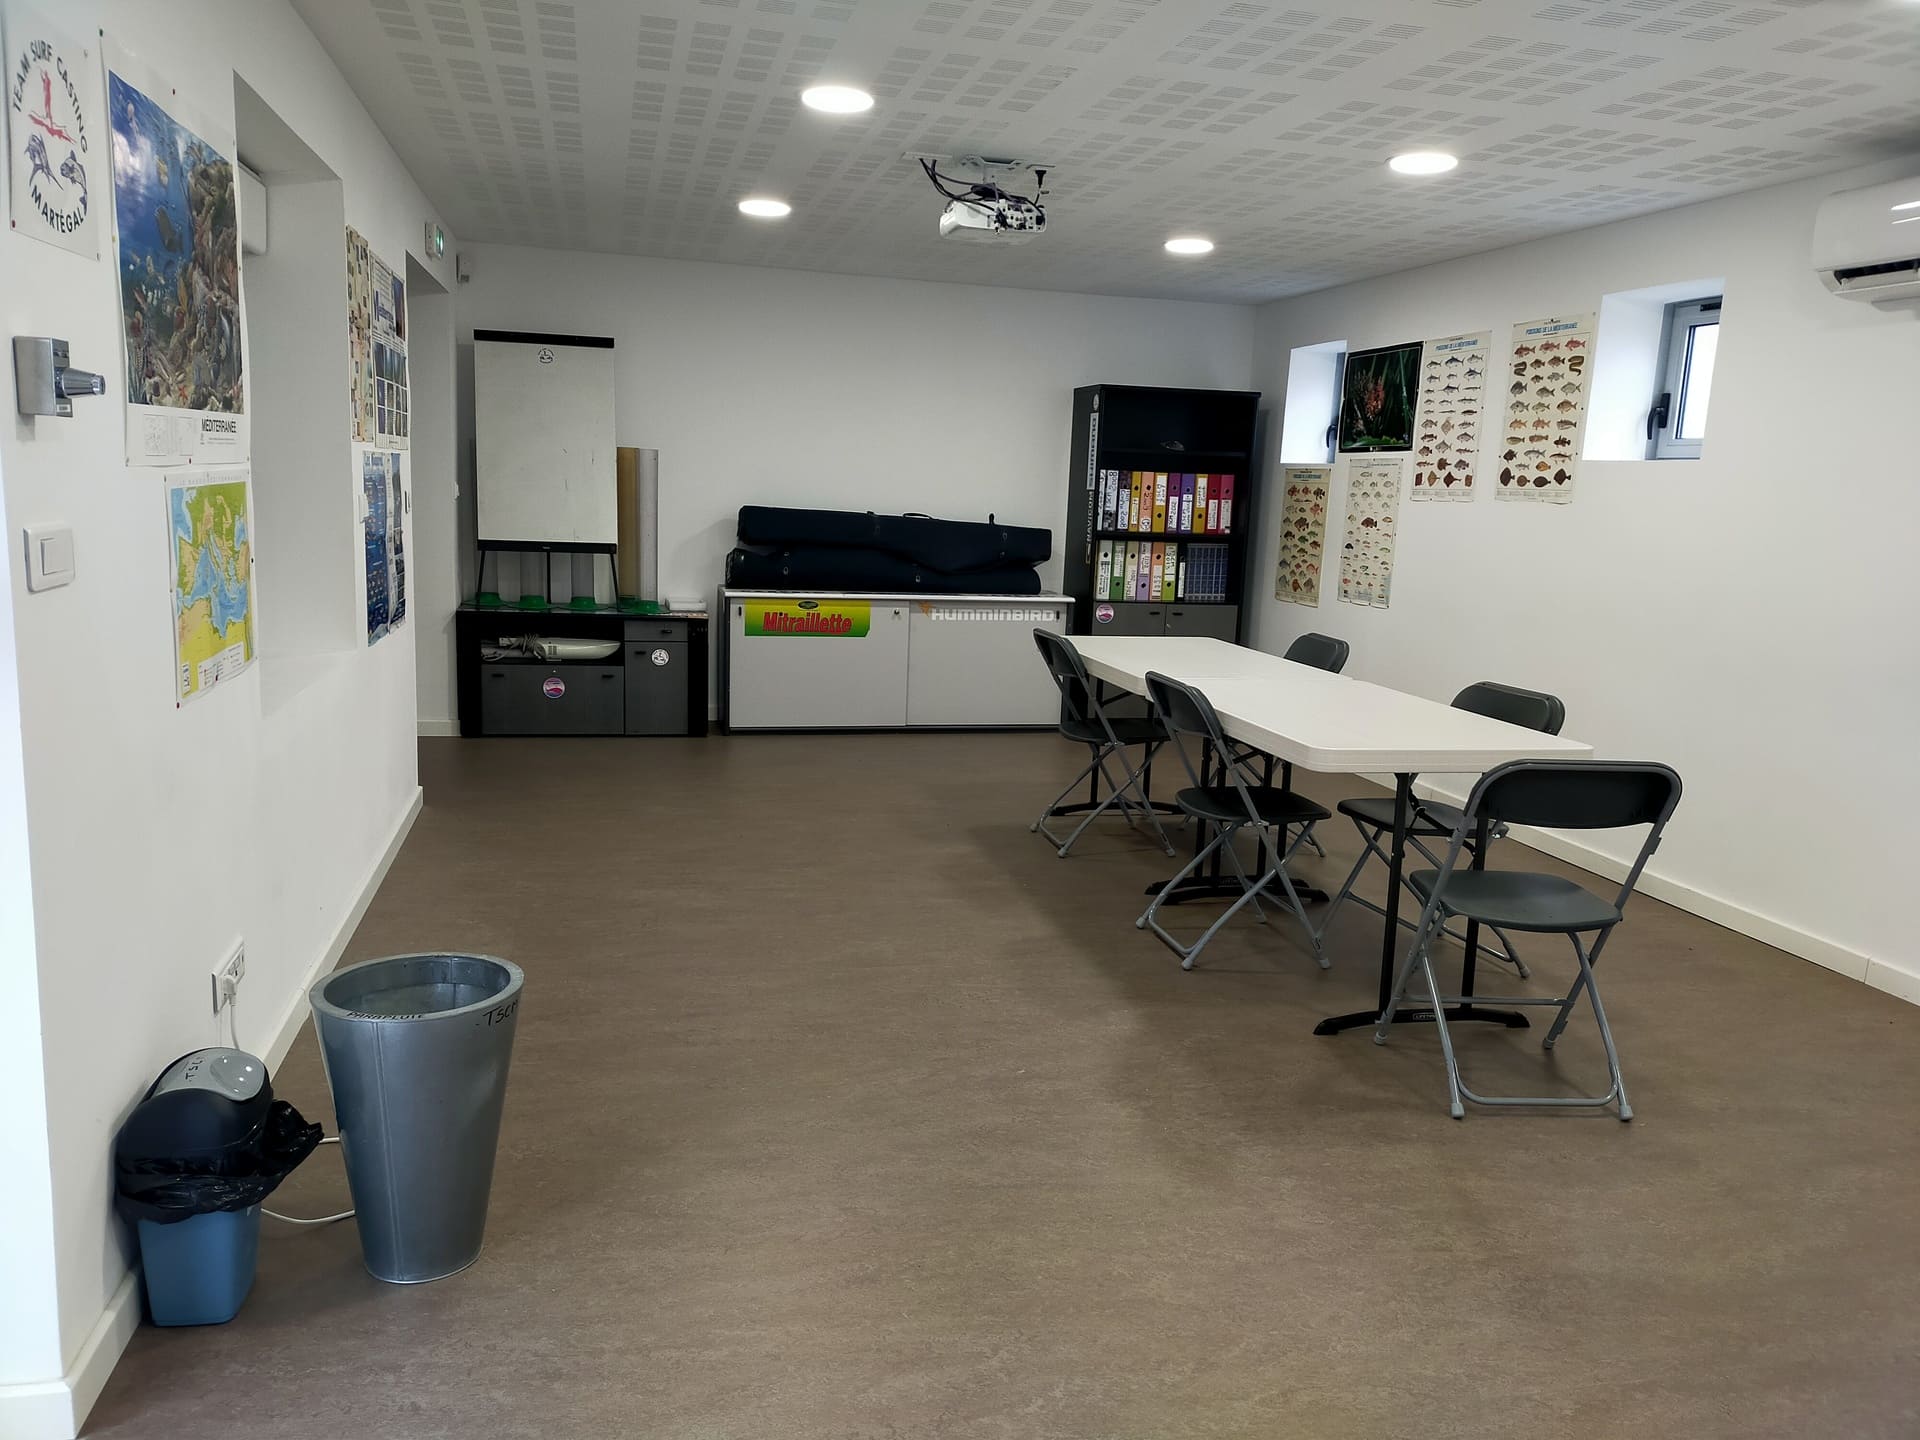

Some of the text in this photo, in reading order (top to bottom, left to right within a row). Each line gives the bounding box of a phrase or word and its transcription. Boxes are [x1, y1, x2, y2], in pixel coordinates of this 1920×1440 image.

[12, 39, 89, 155] TEAM SURF CASTING
[30, 184, 85, 234] MARTÉGAL
[1086, 490, 1094, 542] NAVICOM
[762, 611, 853, 634] Mitraillette
[931, 608, 1055, 622] HUMMINBIRD
